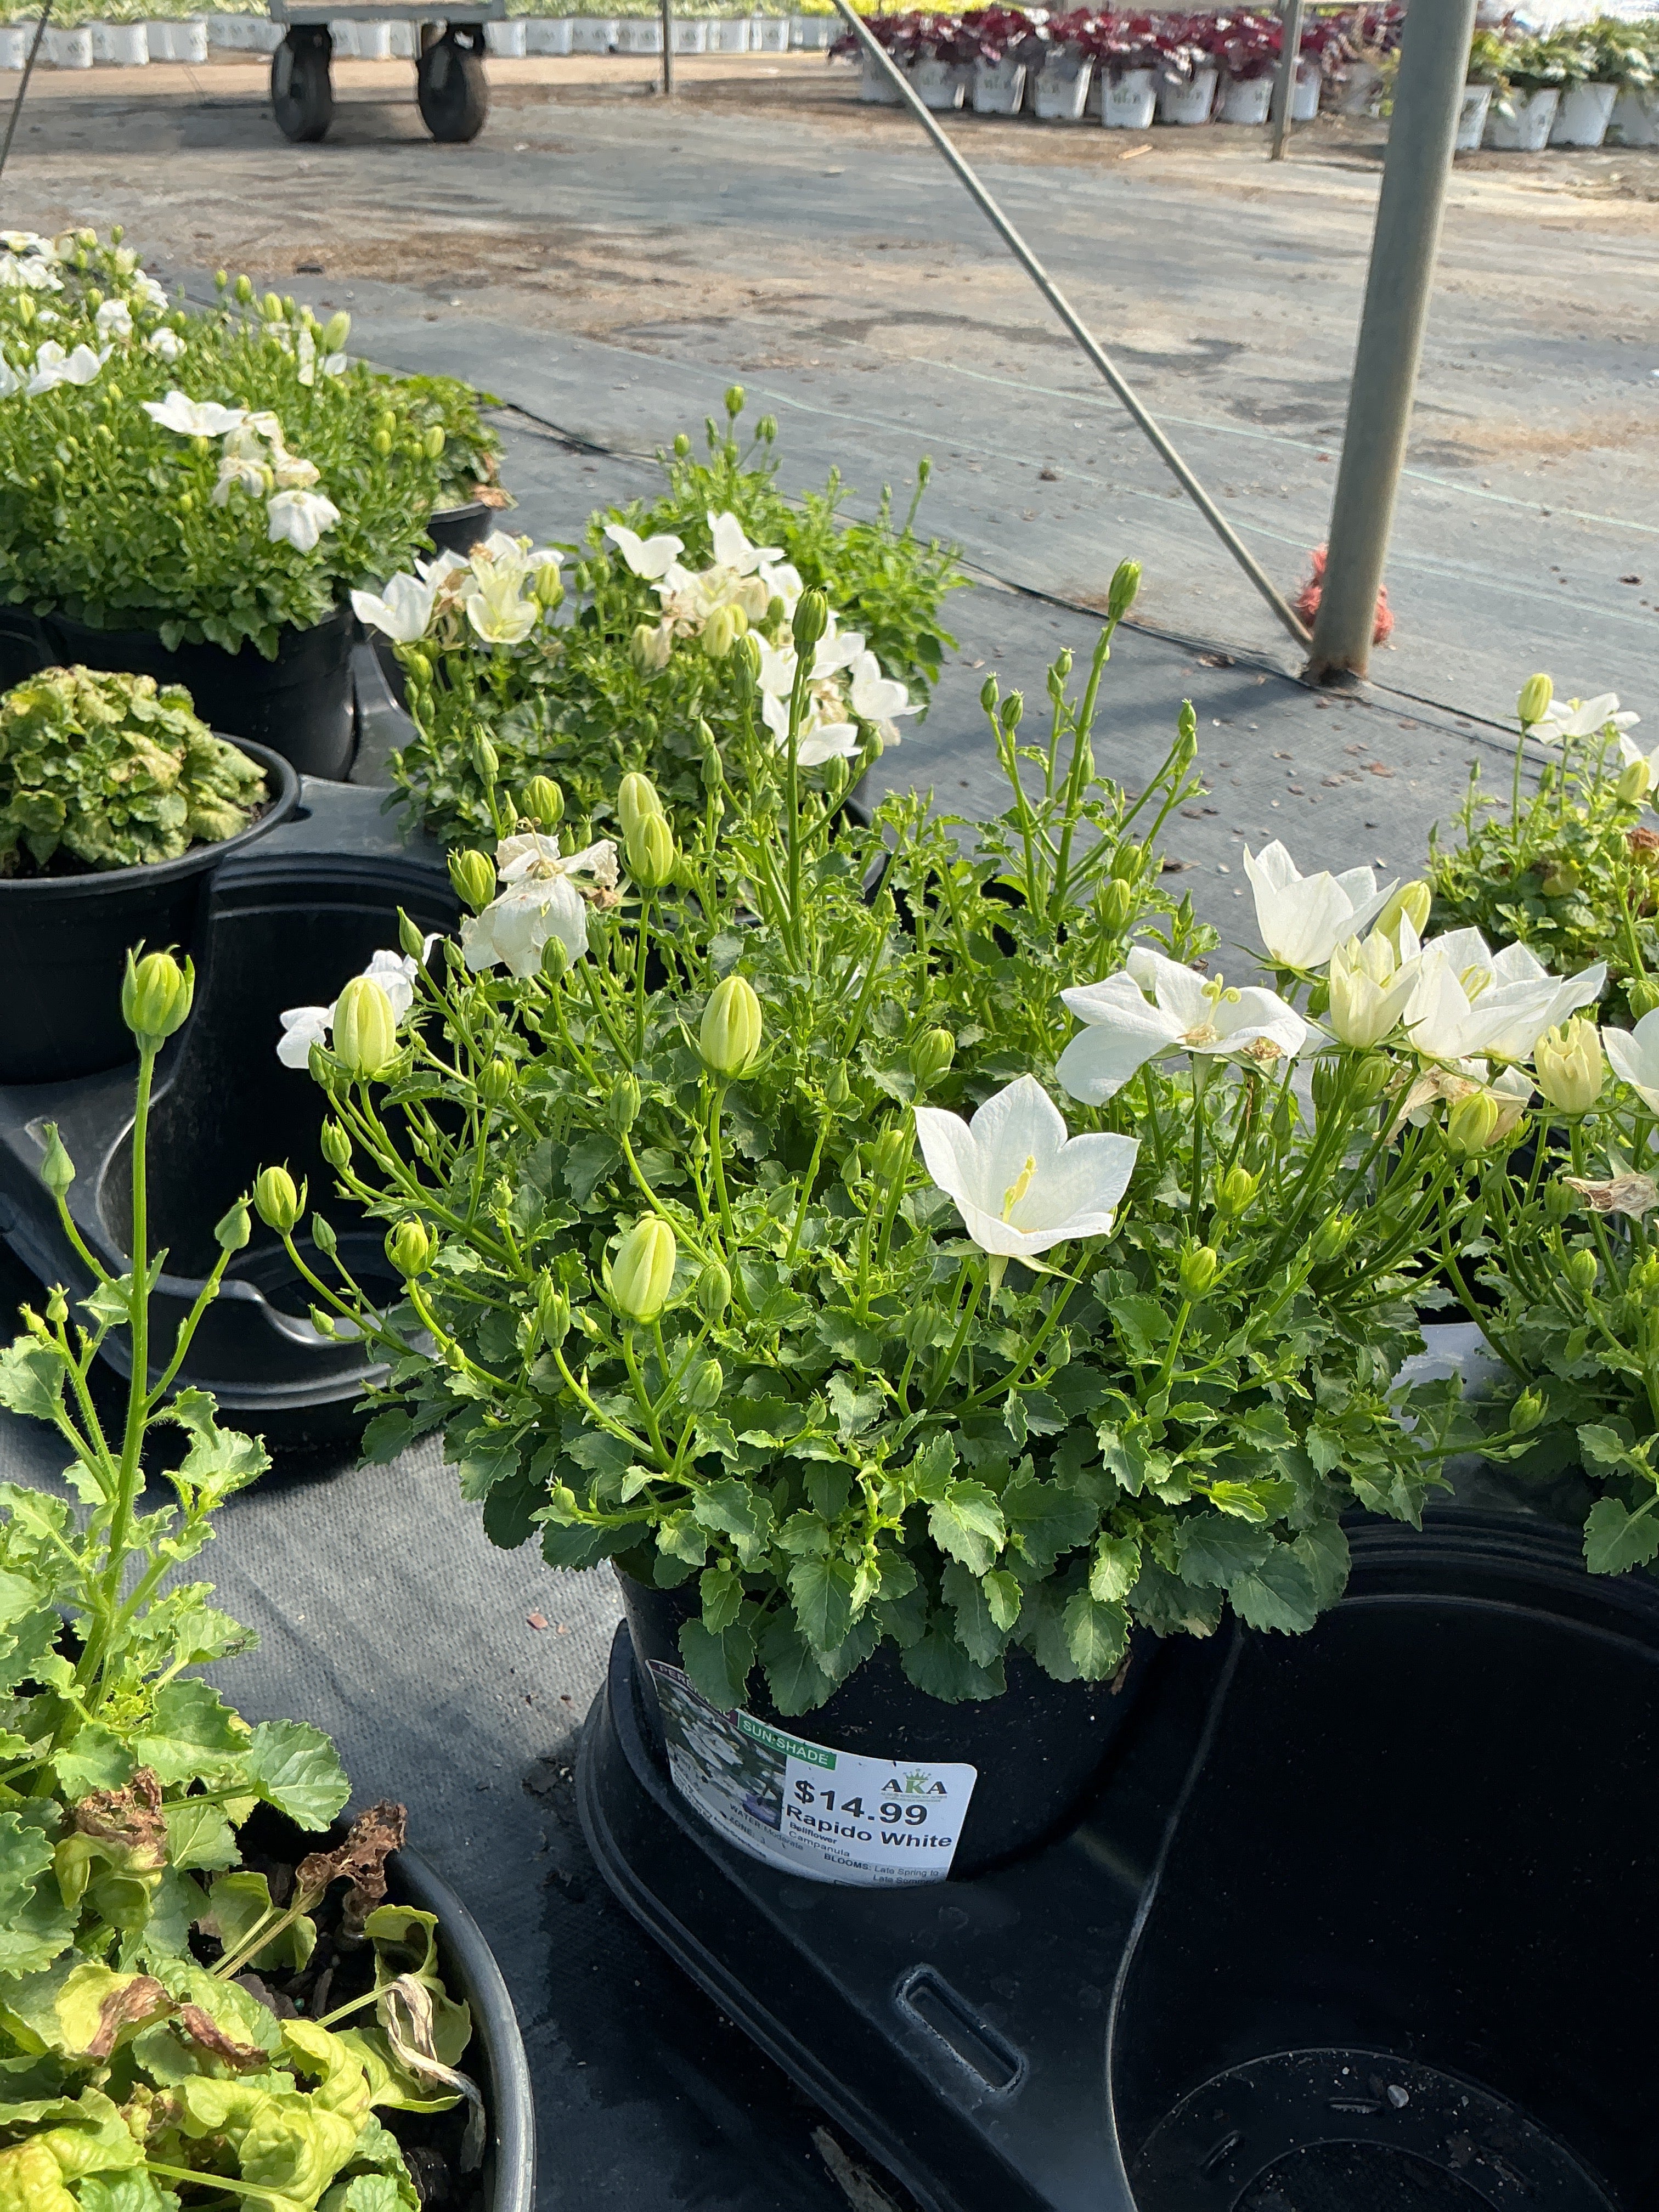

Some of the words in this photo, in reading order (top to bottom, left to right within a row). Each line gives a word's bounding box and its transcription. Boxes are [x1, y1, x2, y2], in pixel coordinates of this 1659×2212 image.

[881, 1778, 948, 1795] AKA
[794, 1780, 928, 1825] $14.99
[786, 1804, 872, 1841] Rapido
[881, 1831, 952, 1847] White
[789, 1821, 837, 1844] Bellflower
[789, 1831, 850, 1857] Campanula
[824, 1853, 872, 1870] BLOOMS:
[874, 1865, 895, 1874] Late
[897, 1868, 927, 1877] Spring
